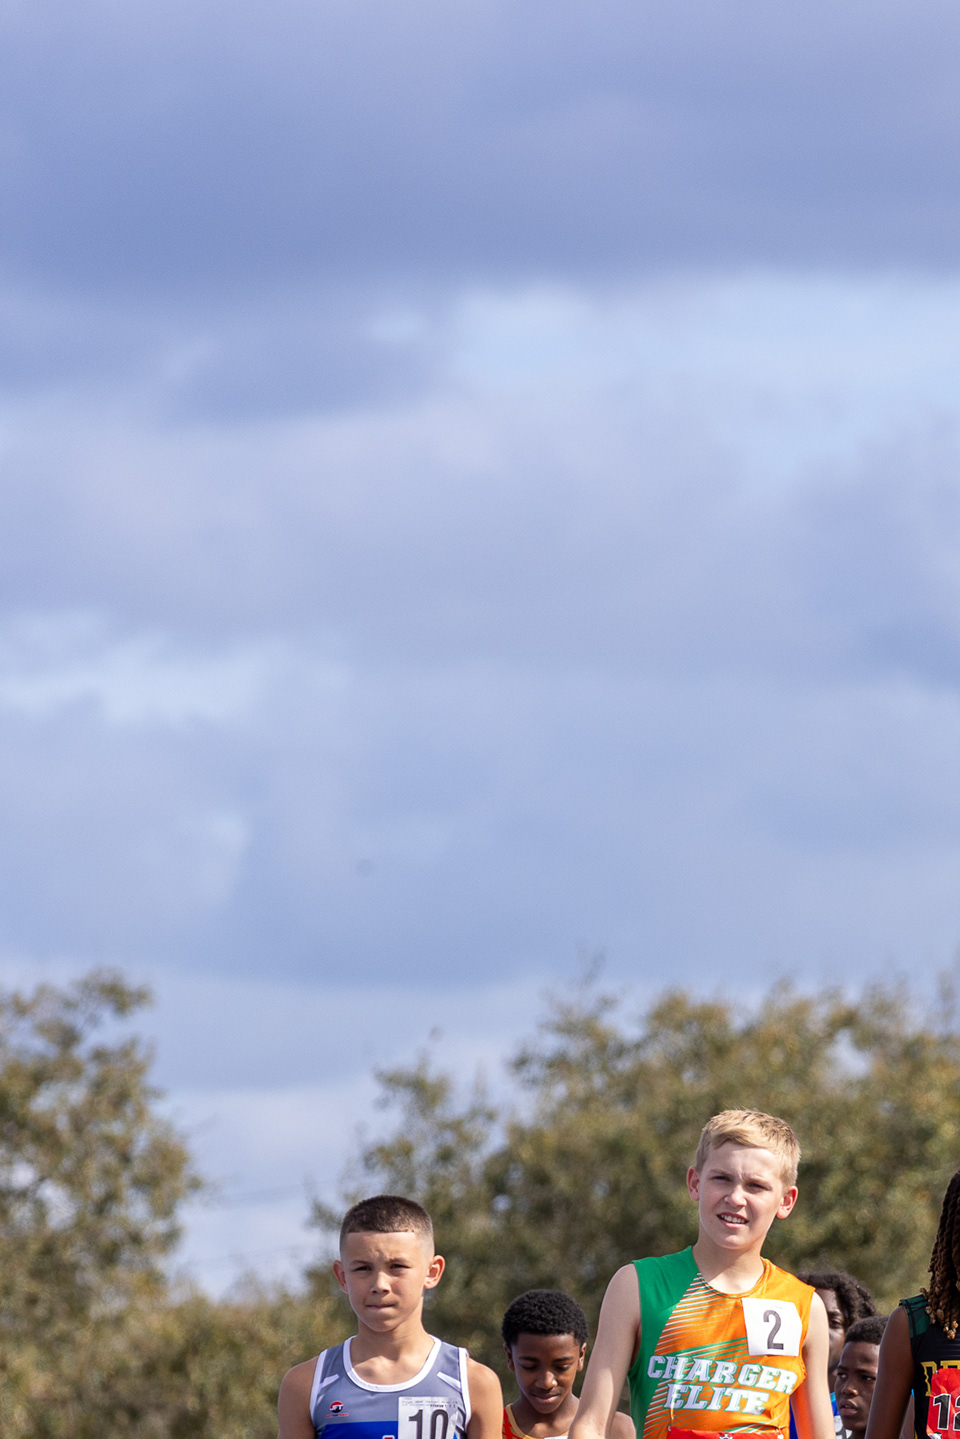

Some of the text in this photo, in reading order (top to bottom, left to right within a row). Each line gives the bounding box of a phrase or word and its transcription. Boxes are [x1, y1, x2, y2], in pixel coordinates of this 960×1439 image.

[762, 1309, 785, 1350] 2
[647, 1355, 798, 1395] CHARGER
[664, 1383, 770, 1415] ELITE
